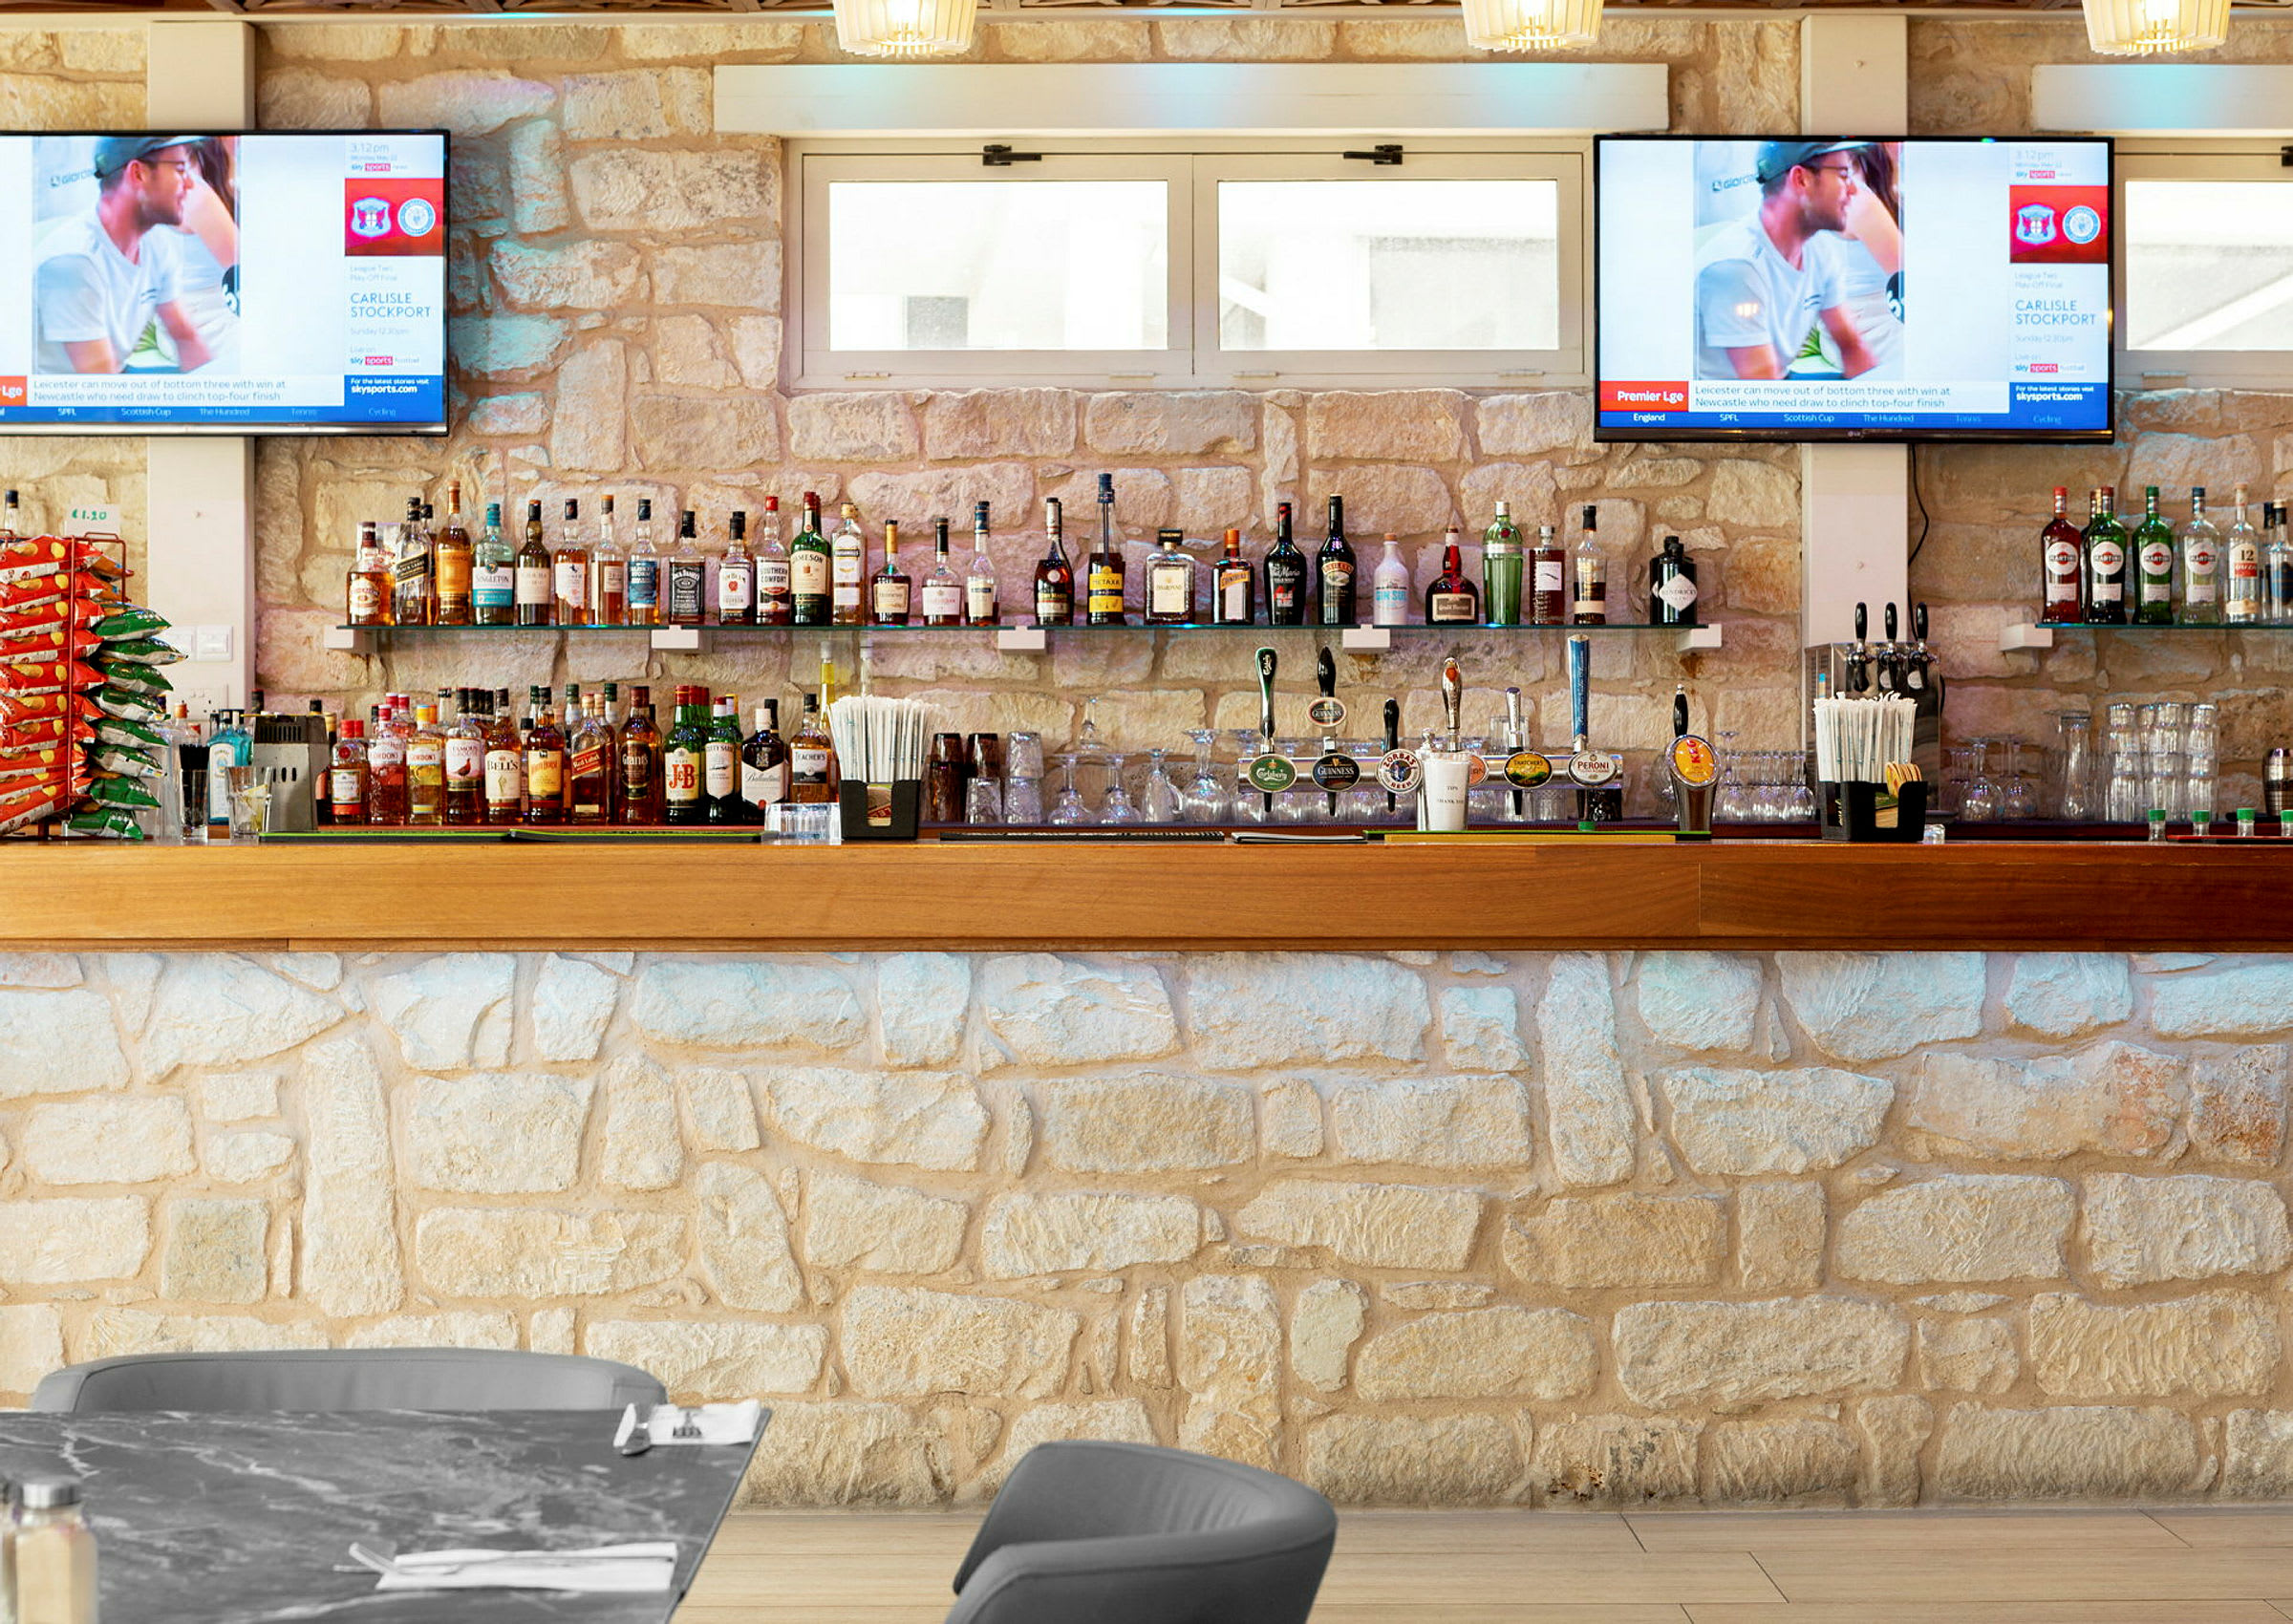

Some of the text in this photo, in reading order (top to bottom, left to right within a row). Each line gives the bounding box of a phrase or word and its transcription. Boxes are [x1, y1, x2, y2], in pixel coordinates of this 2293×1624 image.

[351, 292, 412, 304] CARLISLE
[2015, 299, 2077, 310] CARLISLE
[351, 307, 431, 318] STOCKPORT
[2016, 313, 2096, 325] STOCKPORT
[365, 356, 393, 365] sports
[2030, 363, 2058, 372] sports
[33, 380, 286, 389] Leicester can move out of bottom three with win at
[352, 384, 418, 395] skysports.com
[1695, 386, 1950, 395] Leicester can move out of bottom three with win at
[33, 392, 281, 401] Newcastle who need draw to clinch top-four finish
[1618, 391, 1684, 404] Premier Lge
[2016, 392, 2083, 402] skysports.com
[1695, 398, 1945, 407] Newcastle who need draw to clinch top-four finish
[121, 407, 172, 417] Scottish Cup
[368, 408, 396, 417] Cycling
[1633, 413, 1665, 422] England
[1783, 414, 1834, 423] Scottish Cup
[1879, 414, 1914, 422] Hundred
[2240, 549, 2254, 561] 12
[573, 753, 600, 768] Red Label
[622, 753, 649, 765] Grant's
[1383, 753, 1416, 767] ZORBAS
[487, 759, 519, 771] BELL'S
[1318, 764, 1355, 775] GUINNESS
[1577, 760, 1609, 769] PERONI
[1256, 767, 1288, 780] Carlsberg
